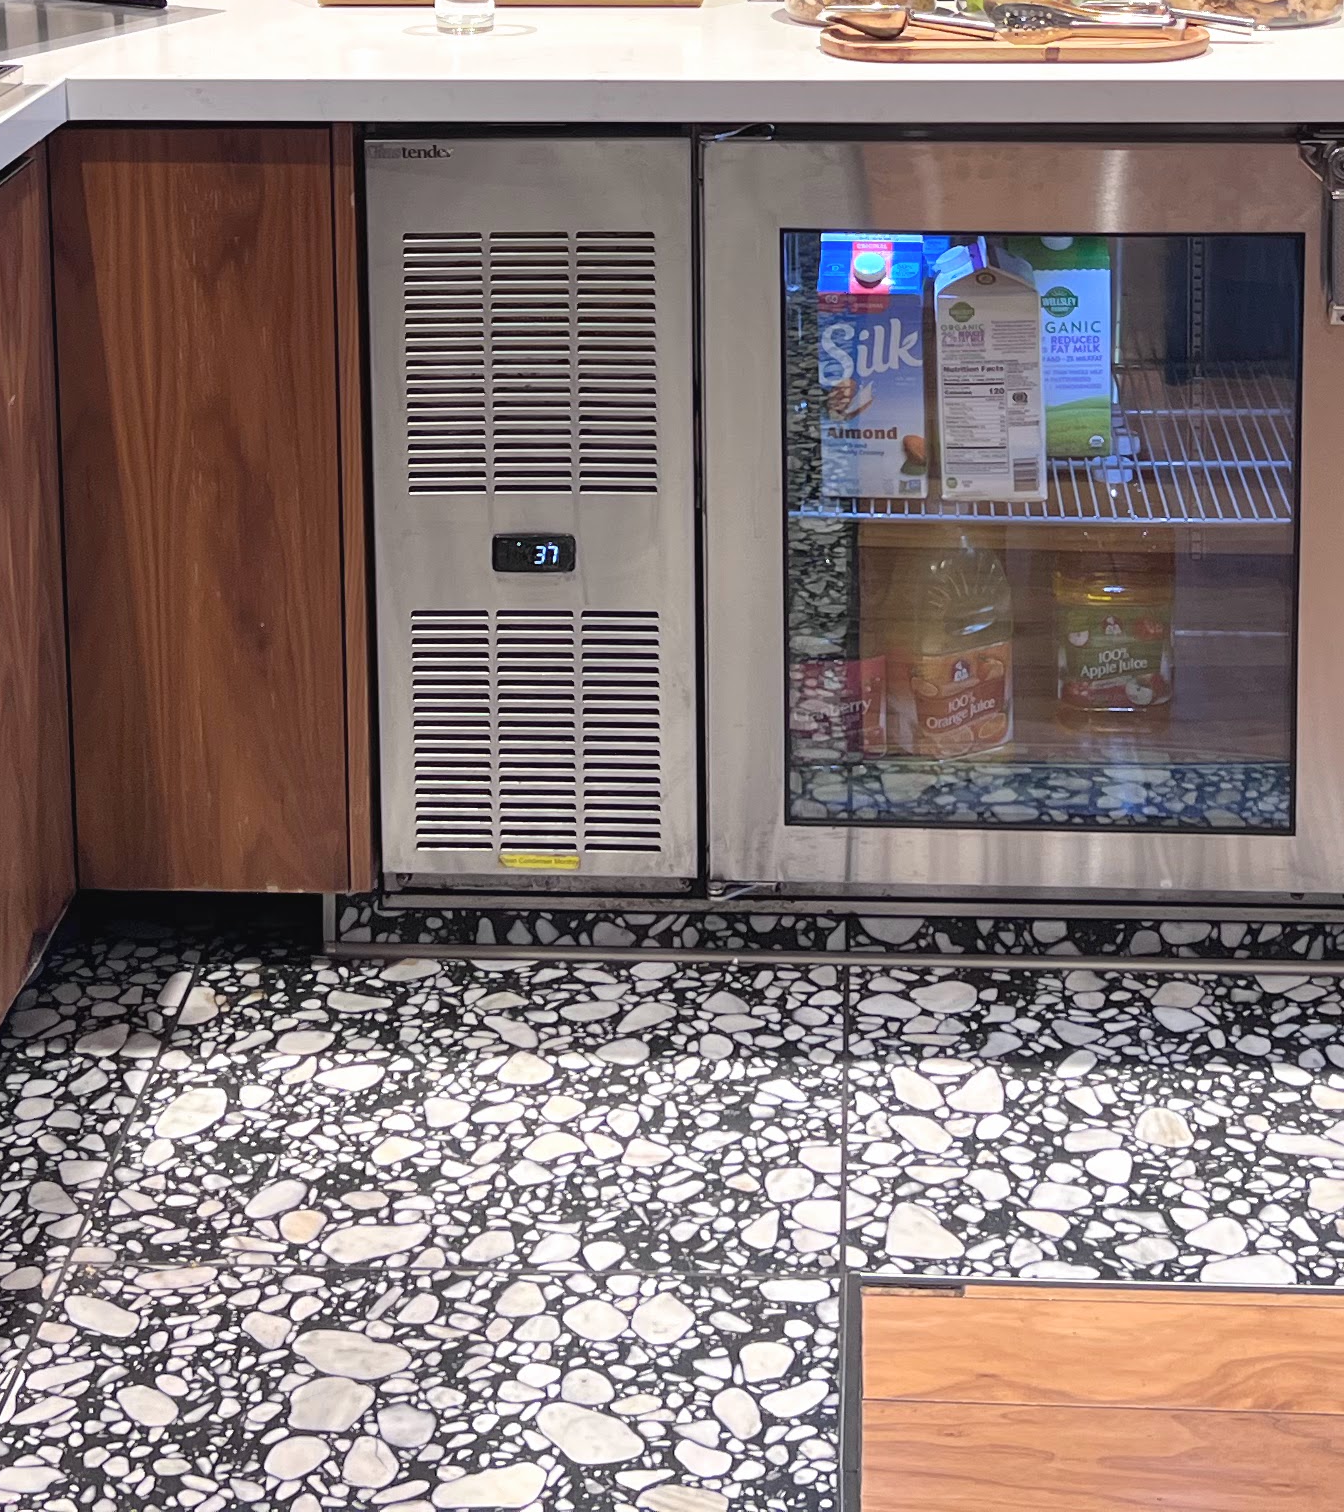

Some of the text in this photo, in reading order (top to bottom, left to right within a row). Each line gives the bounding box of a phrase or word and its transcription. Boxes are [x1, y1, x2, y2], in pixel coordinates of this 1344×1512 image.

[1044, 320, 1102, 334] GANIC
[1050, 335, 1100, 345] REDUCED
[818, 318, 923, 387] Silk
[1051, 344, 1101, 354] FAT MILK
[981, 365, 1004, 373] Facts
[989, 387, 1005, 395] 120
[827, 426, 898, 440] Almond
[534, 545, 559, 565] 37
[1099, 647, 1130, 664] 100%
[1080, 658, 1148, 680] Apple Juice
[947, 690, 977, 713] 100%
[925, 697, 996, 730] Orange Juice
